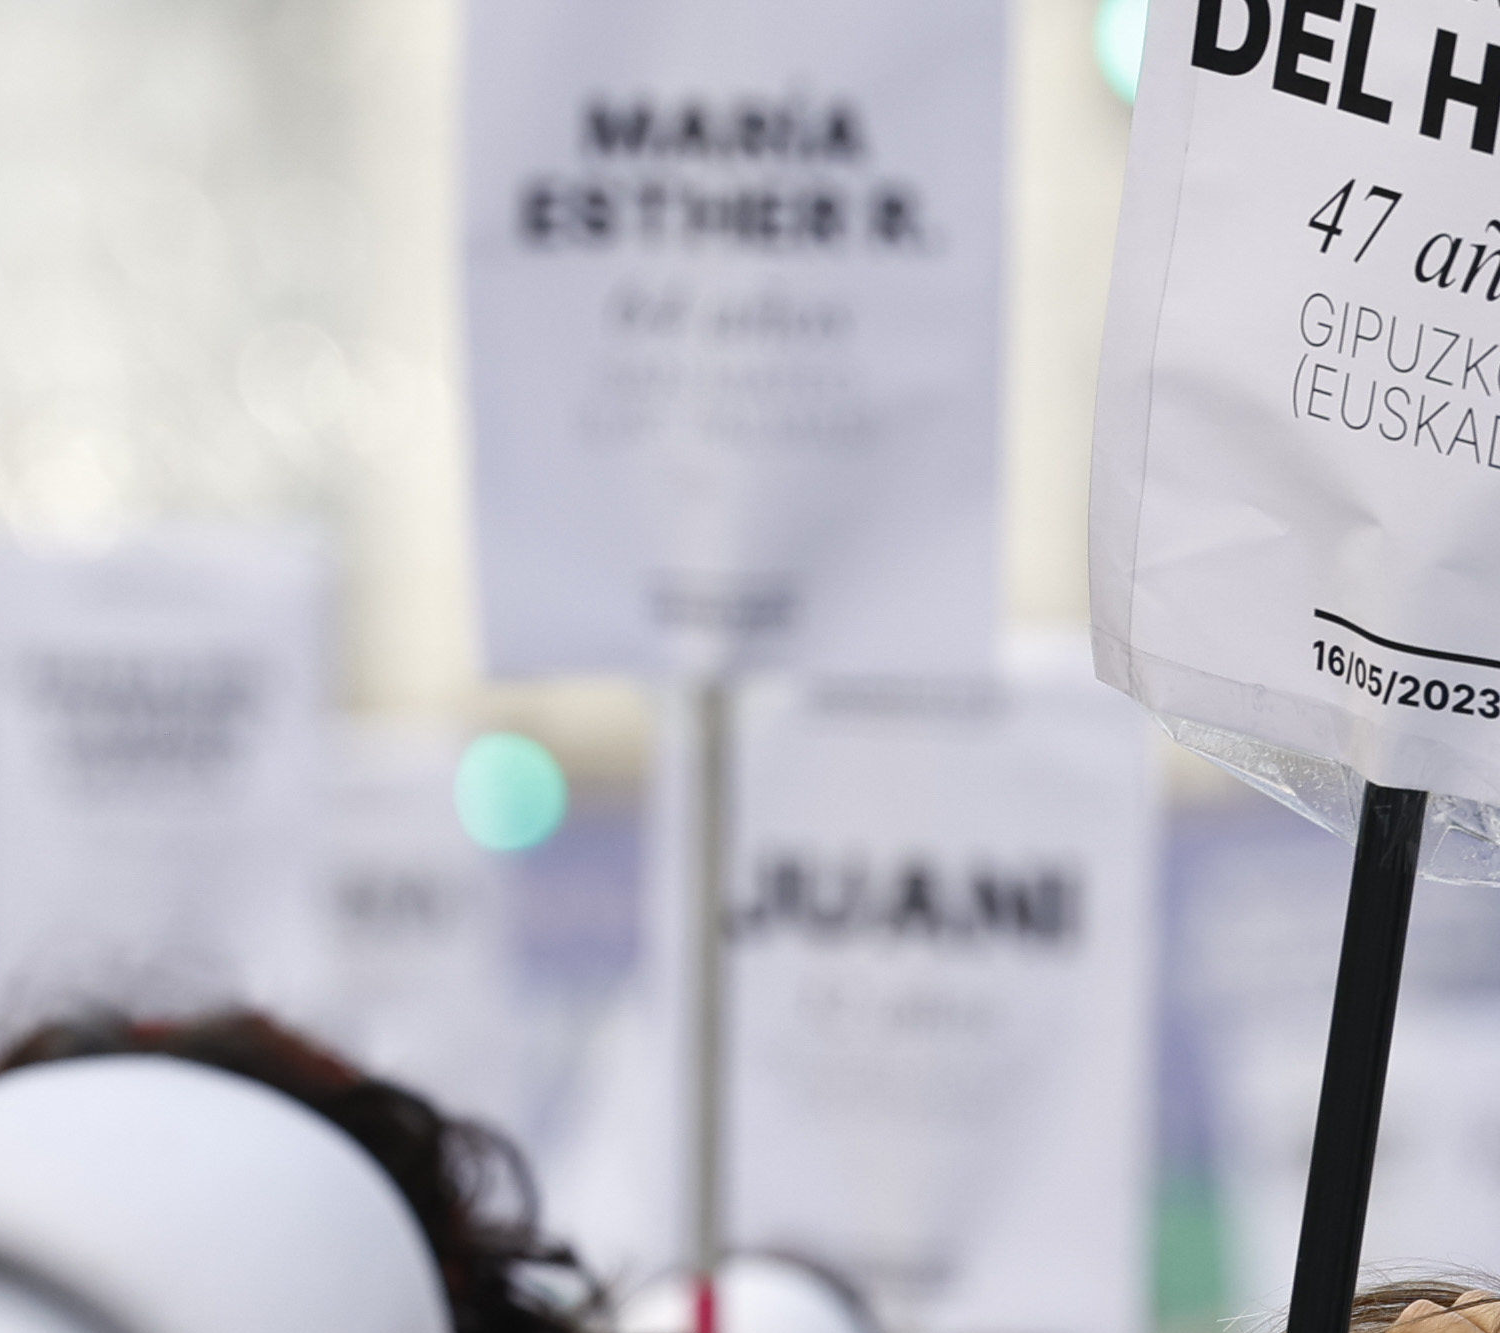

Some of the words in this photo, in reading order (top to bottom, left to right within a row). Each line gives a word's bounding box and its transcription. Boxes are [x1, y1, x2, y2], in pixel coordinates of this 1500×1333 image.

[1191, 0, 1394, 124] DEL
[514, 178, 850, 252] ESTHER
[1308, 178, 1404, 263] 47
